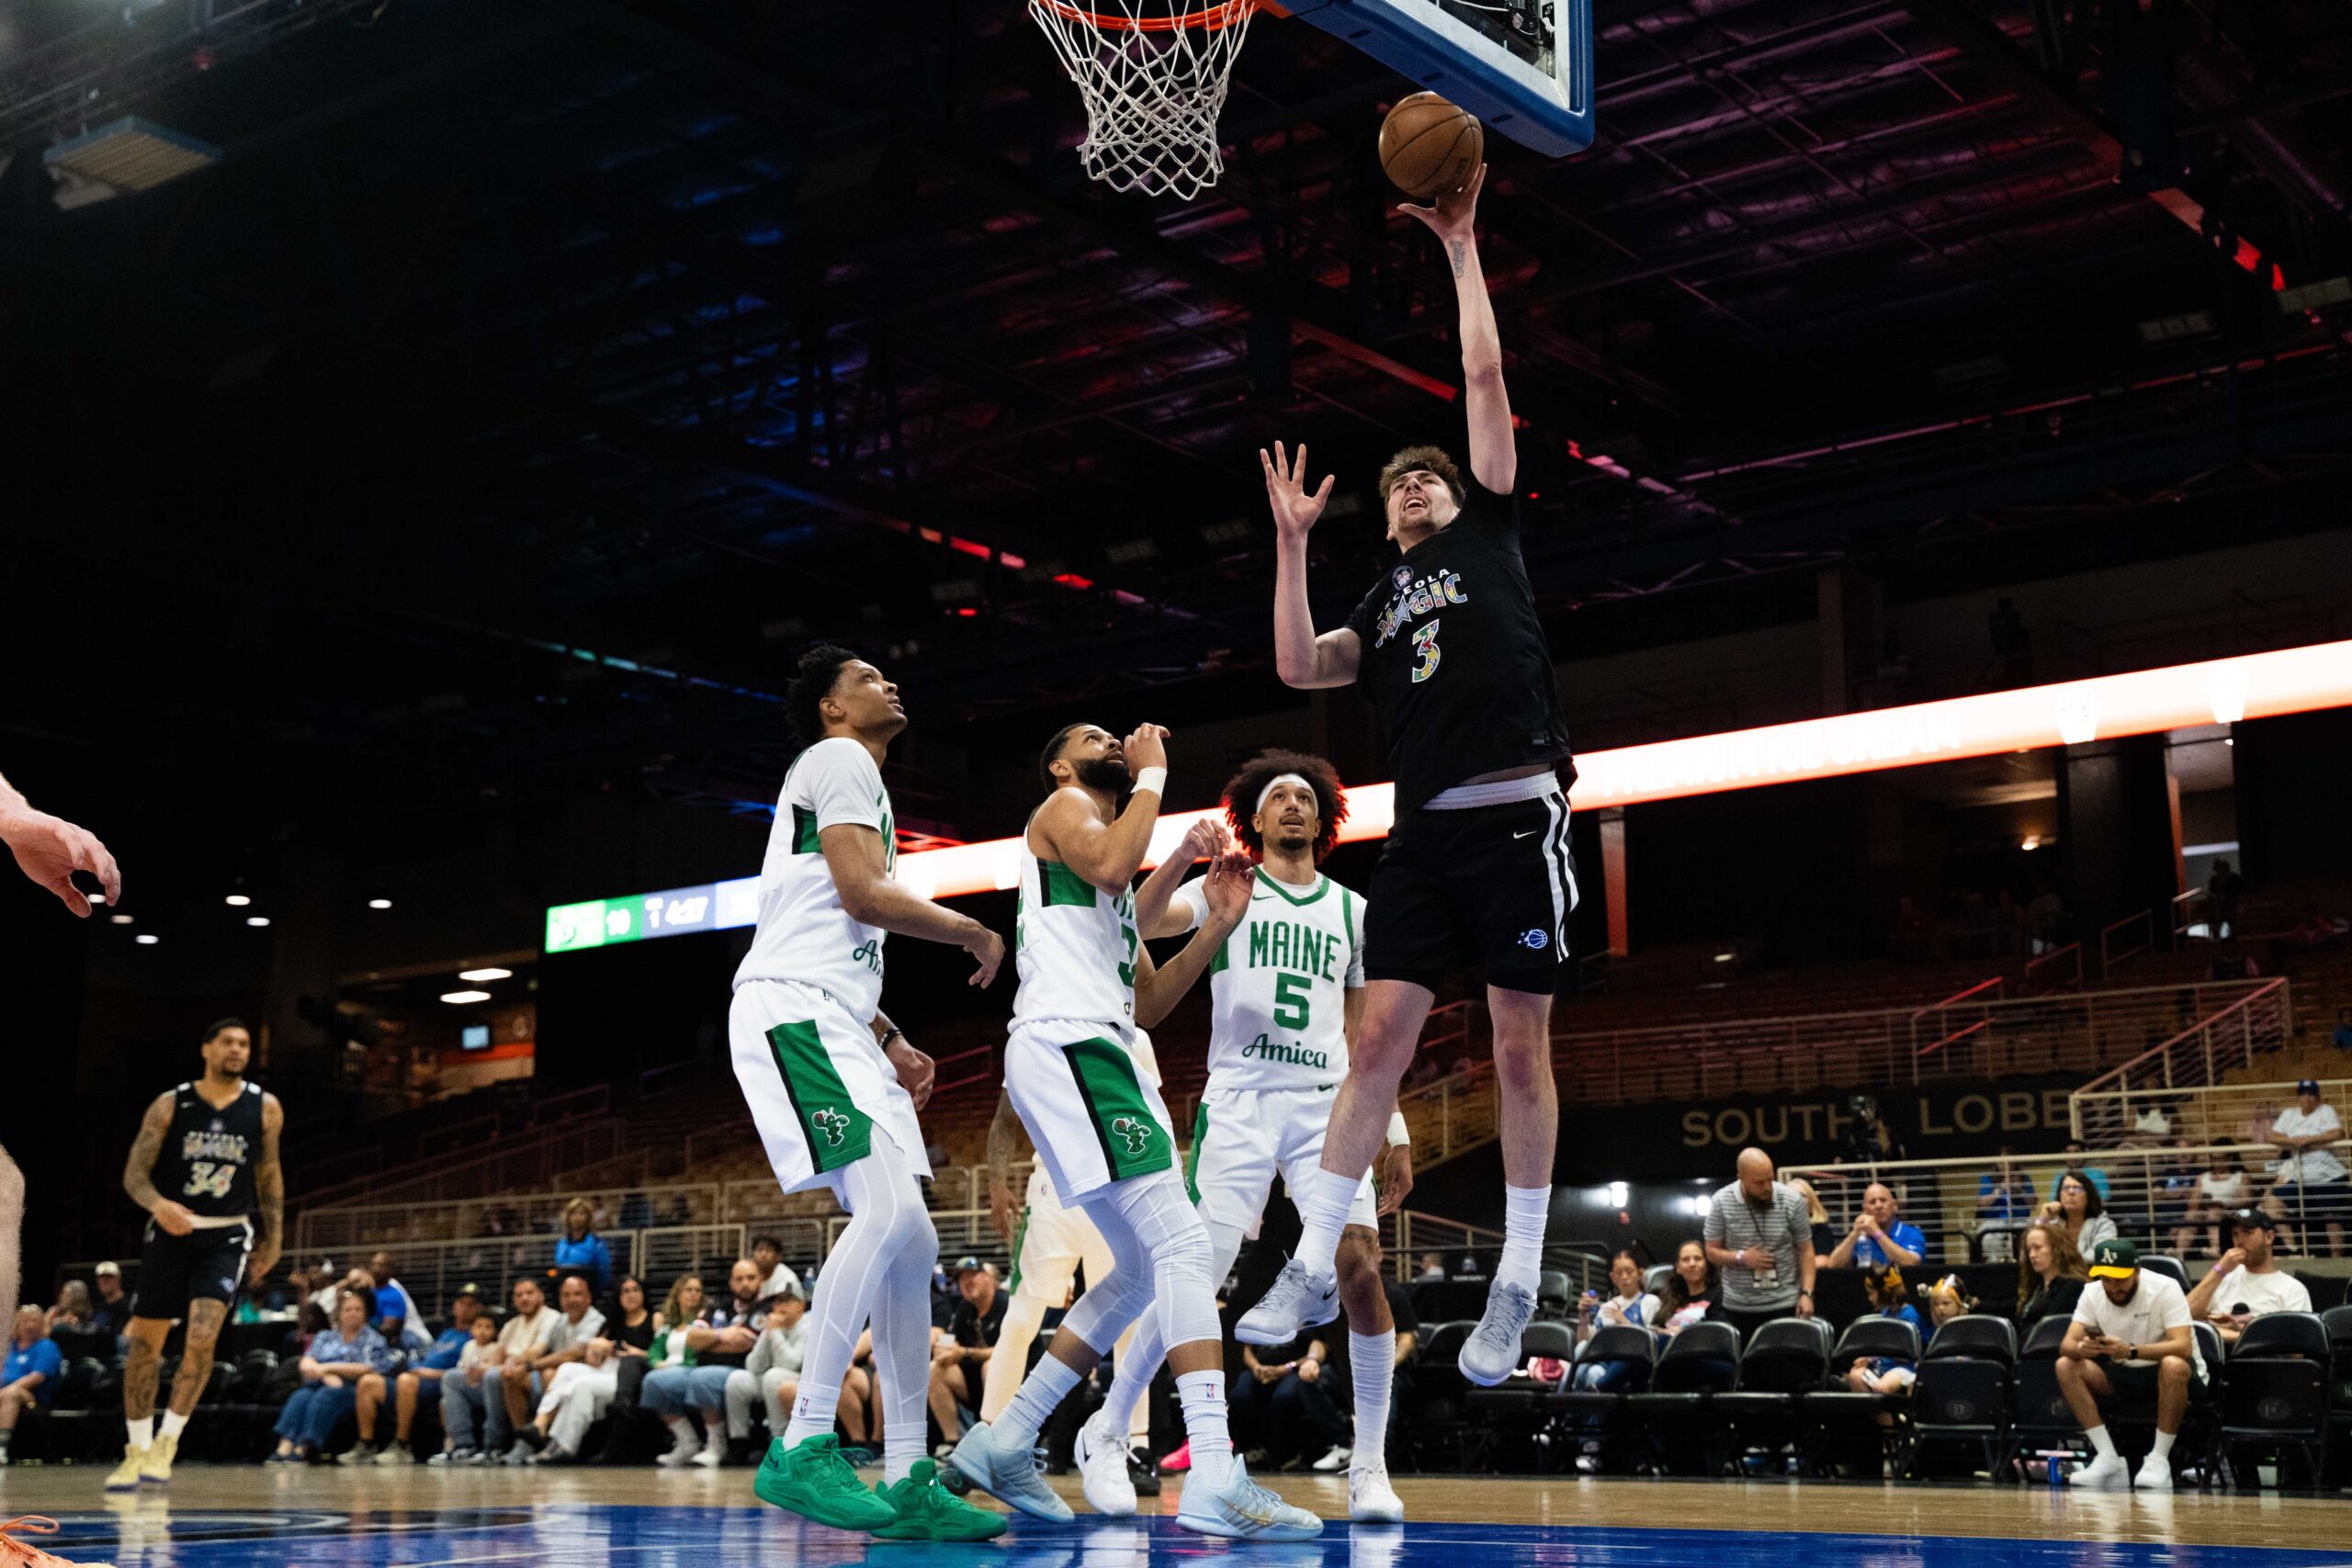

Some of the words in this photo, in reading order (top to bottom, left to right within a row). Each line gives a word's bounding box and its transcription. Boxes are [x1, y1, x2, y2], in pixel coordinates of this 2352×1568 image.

[1377, 569, 1450, 621] CEOLA
[1412, 618, 1441, 682] 3
[1250, 920, 1341, 983] MAINE
[1273, 972, 1312, 1032] 5
[1242, 1033, 1327, 1068] Amica
[1919, 1089, 2071, 1135] LOBB
[183, 1161, 237, 1199] 34
